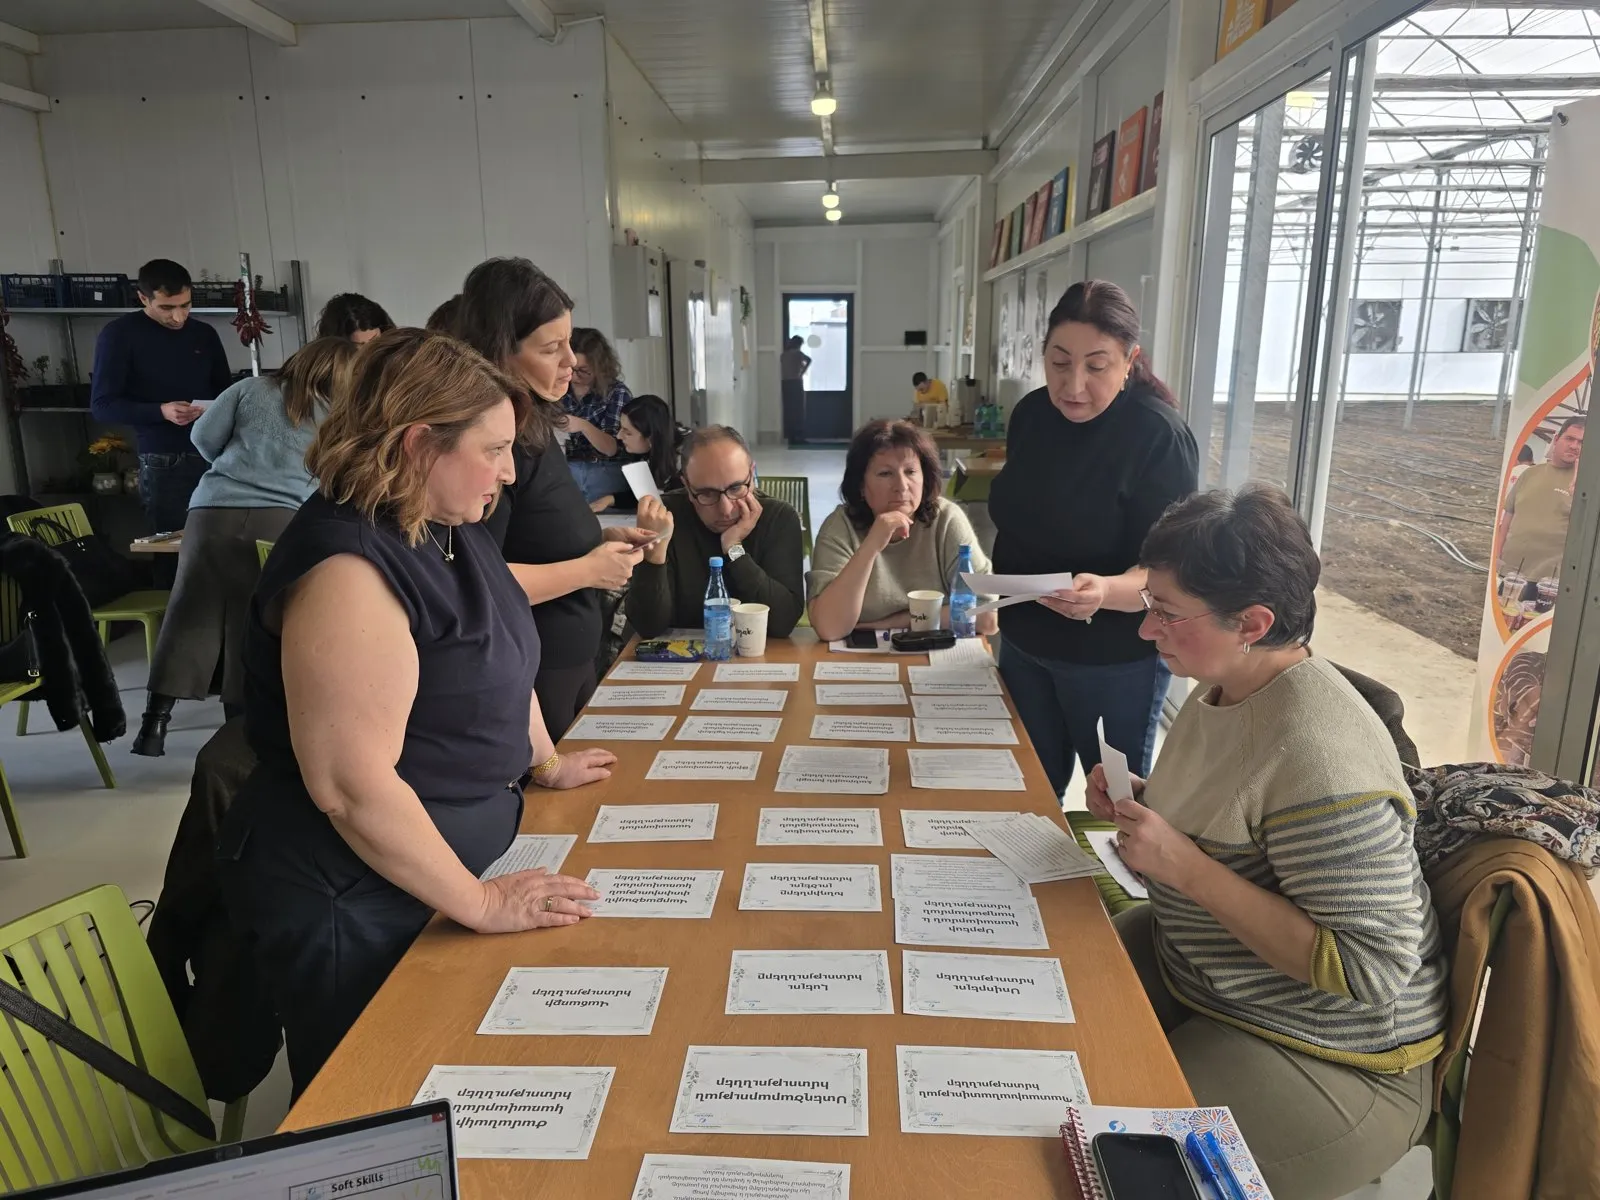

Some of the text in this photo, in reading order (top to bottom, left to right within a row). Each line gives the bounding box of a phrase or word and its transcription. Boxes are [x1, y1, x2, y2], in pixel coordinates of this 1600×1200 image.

[924, 900, 1011, 910] հմտություններ
[922, 909, 1015, 918] հաղթահարման
[933, 917, 1018, 927] կառավարման
[948, 926, 994, 934] Սթրեսի
[757, 972, 862, 981] հմտությունները
[936, 973, 1035, 985] հմտություններ
[532, 988, 632, 997] հմտություններ
[788, 982, 828, 992] Լսելու
[953, 984, 1020, 995] Սովորելու
[544, 999, 609, 1008] Վաճառքի
[716, 1077, 829, 1090] հմտություններ
[946, 1079, 1039, 1091] հմտություններ
[457, 1088, 572, 1099] հմտություններ
[694, 1092, 847, 1104] Ստեղծարարության
[918, 1090, 1072, 1103] Պատասխանատվության
[452, 1102, 564, 1114] կառավարման
[456, 1117, 548, 1129] Ժամանակի
[331, 1172, 384, 1194] Soft Skills
